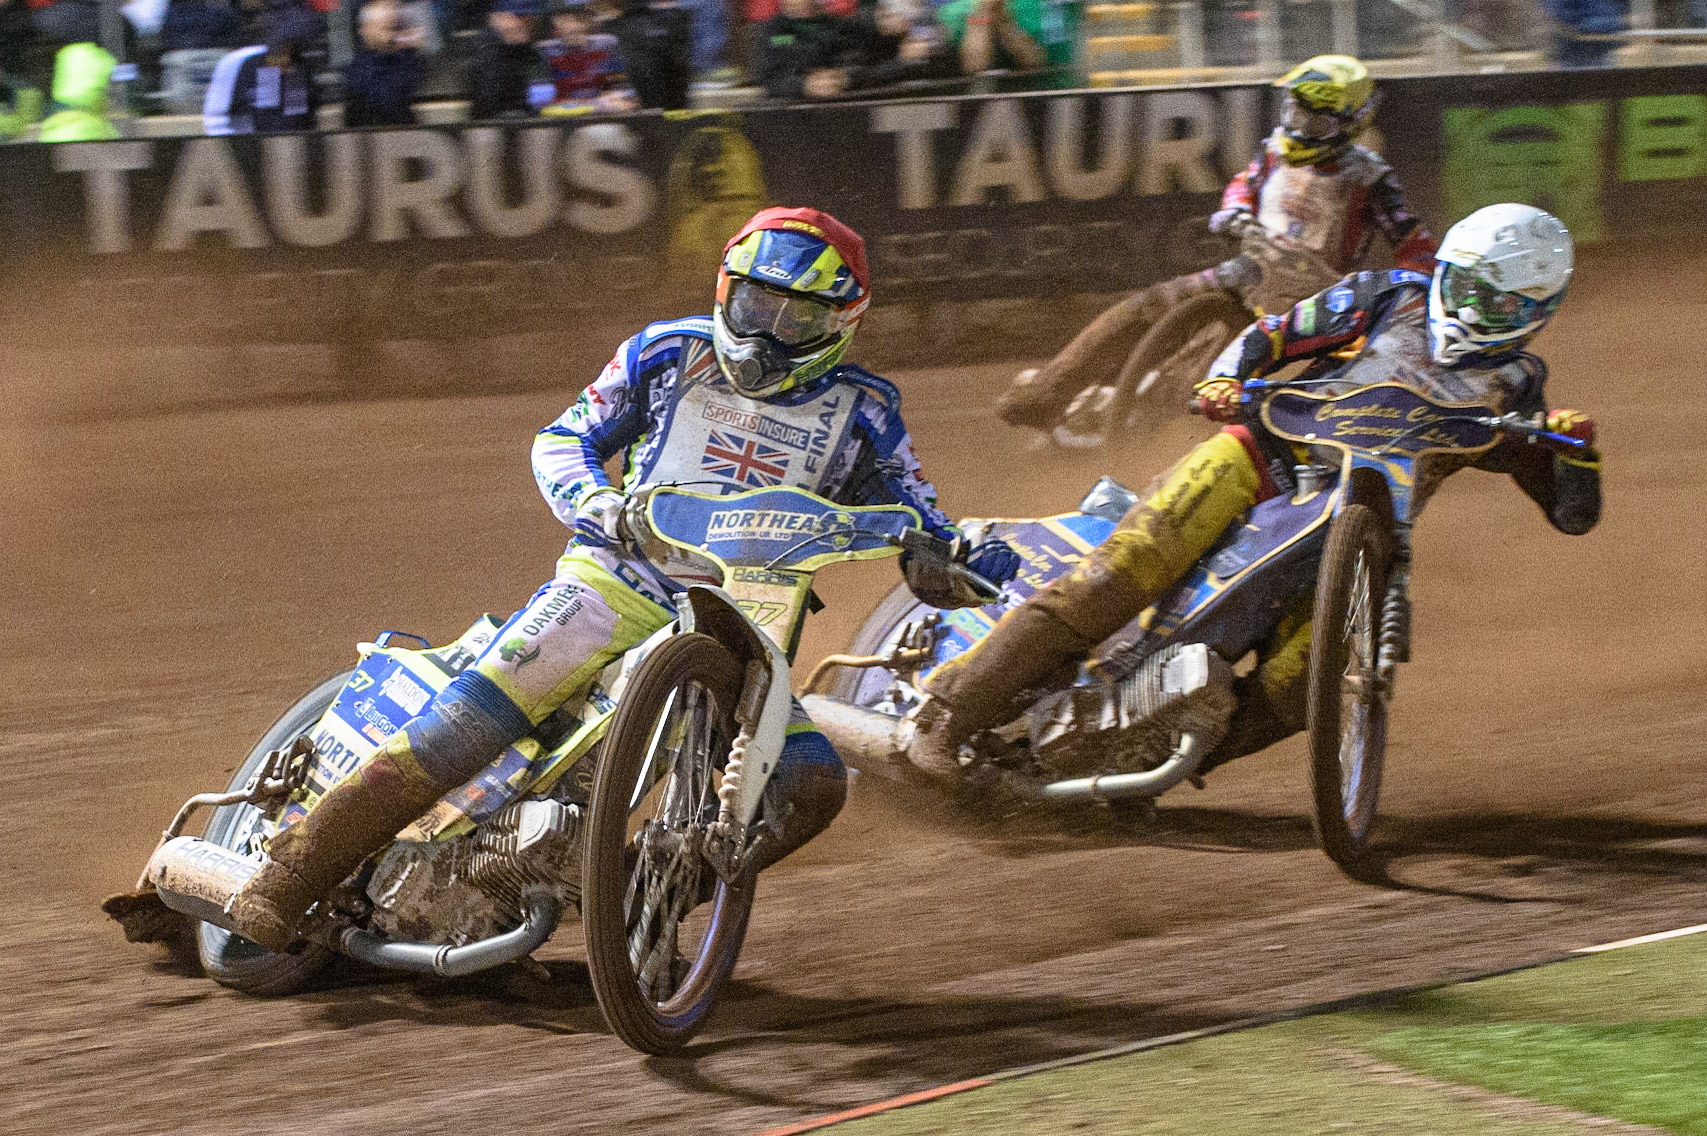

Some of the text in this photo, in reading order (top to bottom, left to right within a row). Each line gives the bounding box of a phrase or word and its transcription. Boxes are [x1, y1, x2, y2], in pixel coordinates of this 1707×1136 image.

[872, 92, 1272, 209] TAUR
[54, 124, 658, 253] TAURUS
[706, 402, 809, 449] SPORTS INSURE
[803, 396, 840, 474] FINAL
[708, 531, 756, 540] DEMOLITION
[733, 567, 799, 587] HARRIS
[555, 598, 585, 626] GROUP
[347, 669, 375, 693] 37
